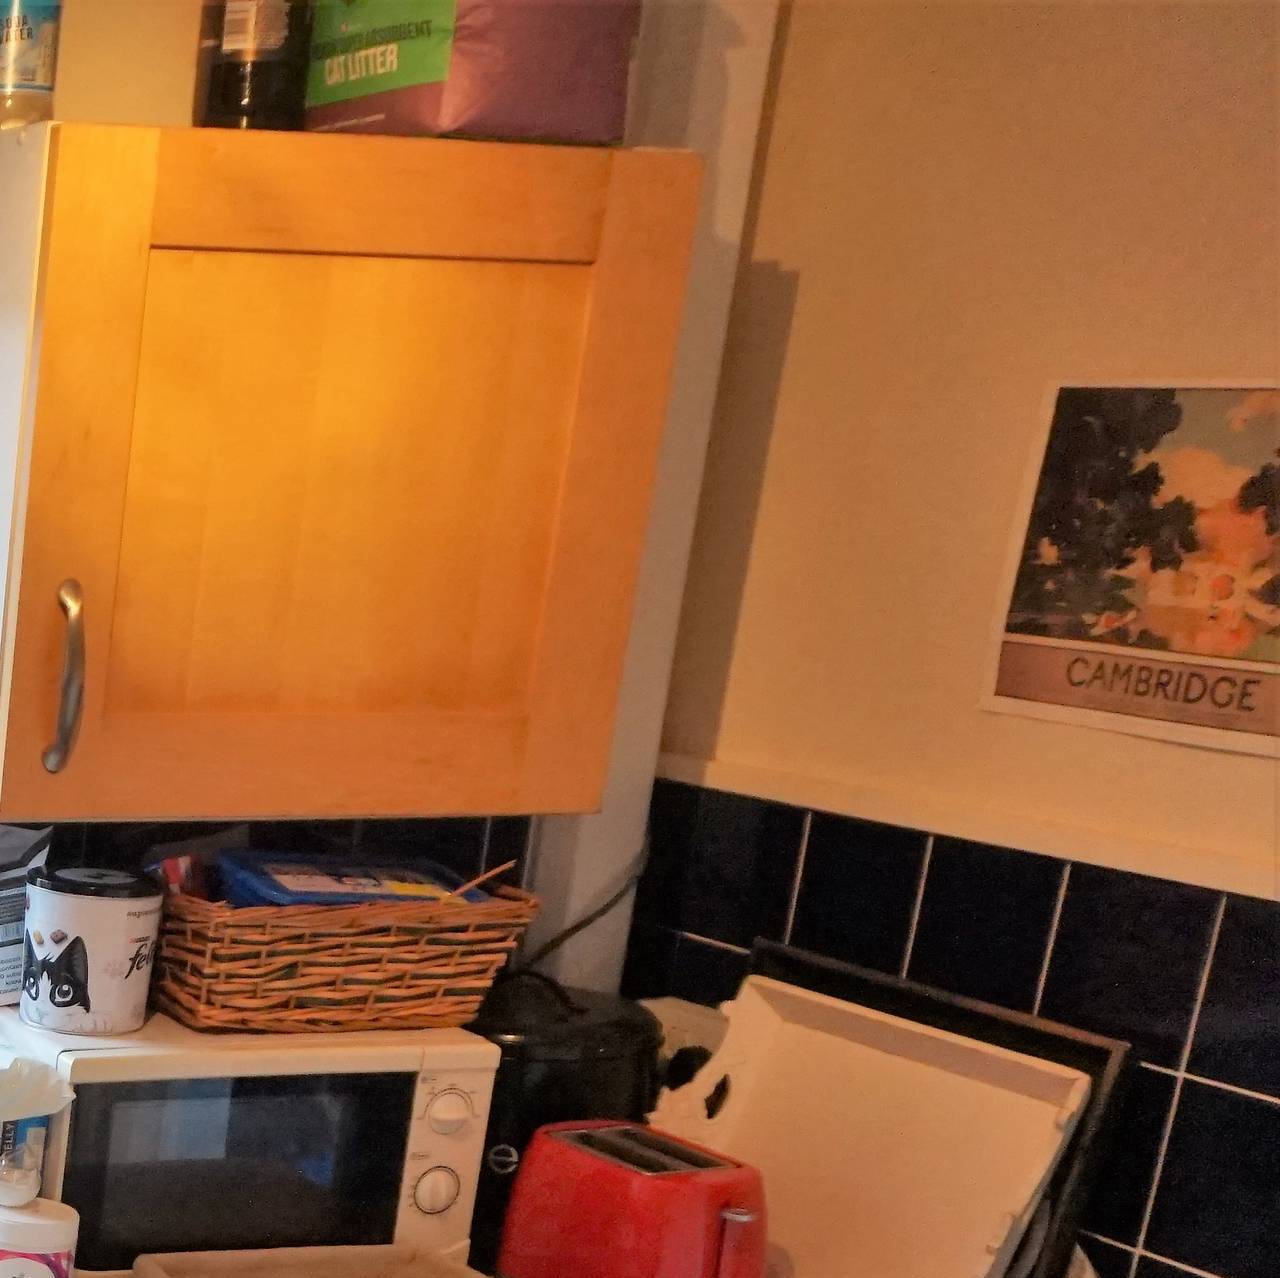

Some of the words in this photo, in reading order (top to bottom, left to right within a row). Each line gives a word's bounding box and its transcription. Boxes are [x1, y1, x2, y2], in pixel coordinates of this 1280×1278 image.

[324, 55, 346, 86] CAT
[347, 42, 400, 81] LITTER
[1065, 656, 1262, 713] CAMBRIDGE
[3, 1123, 16, 1151] ELLY
